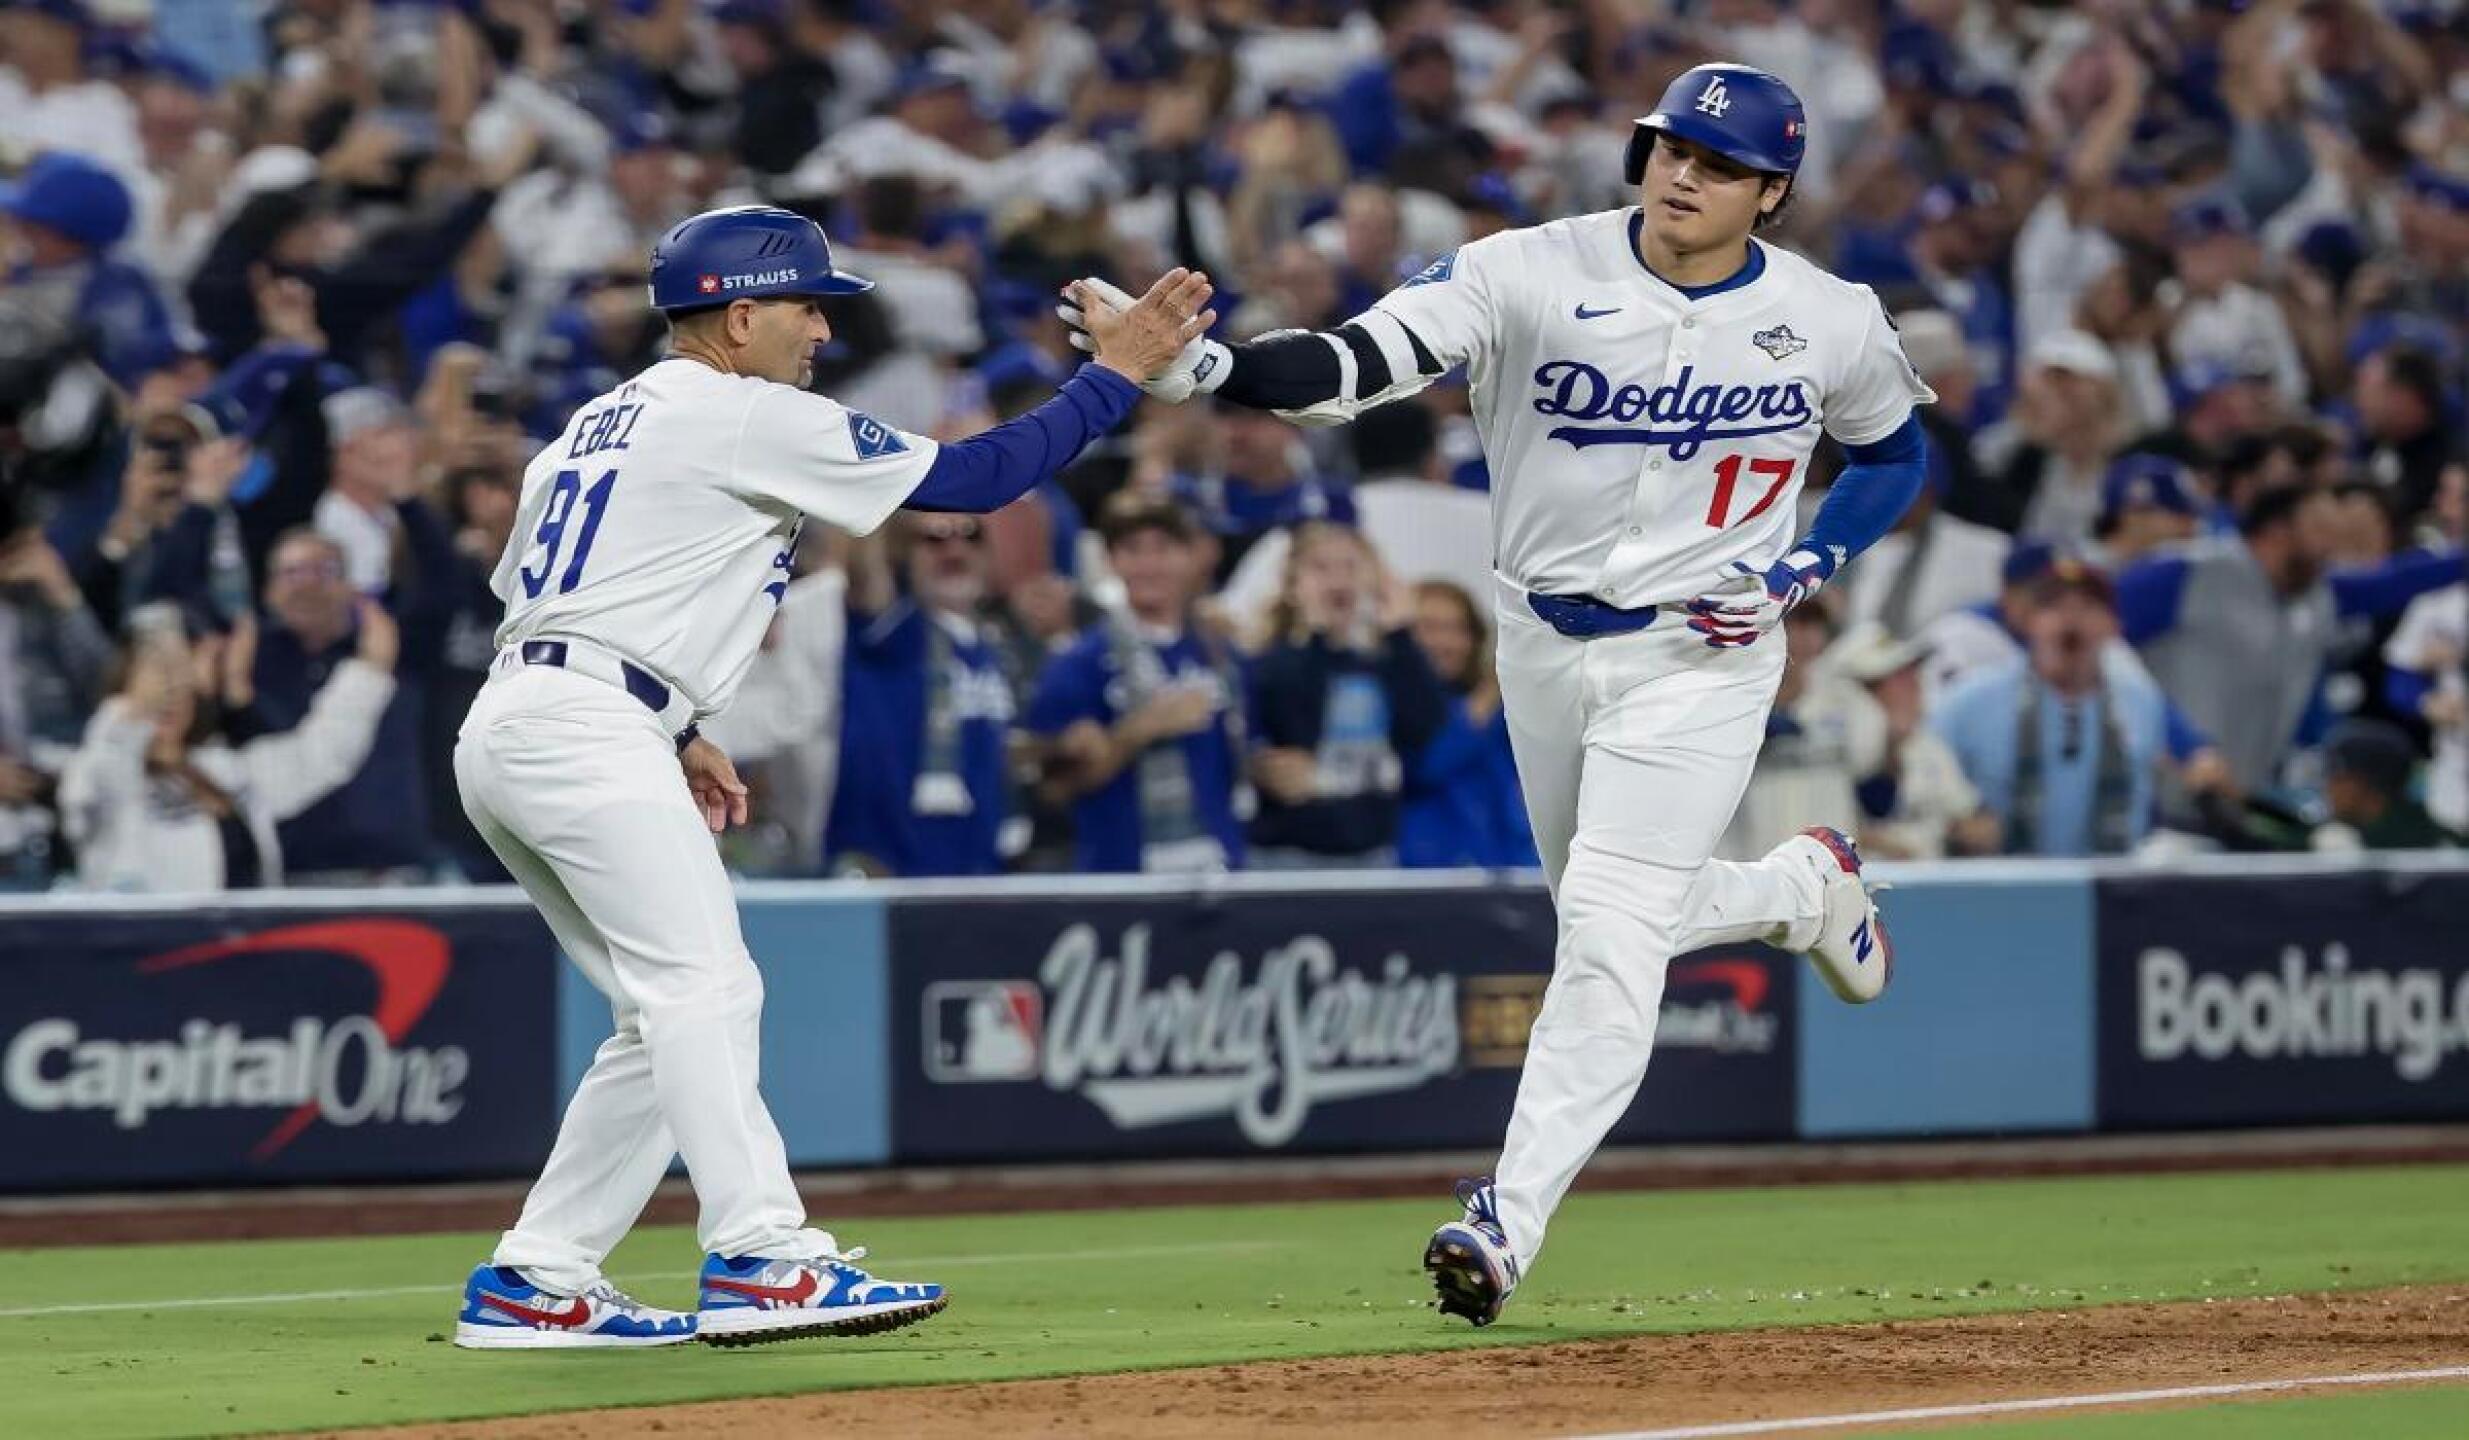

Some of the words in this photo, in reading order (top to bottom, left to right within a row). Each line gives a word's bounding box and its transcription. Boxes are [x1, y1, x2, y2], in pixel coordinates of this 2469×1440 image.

[1695, 75, 1731, 118] LA
[722, 268, 798, 289] STRAUSS
[567, 402, 646, 460] EBEL
[1533, 360, 1813, 462] Dodgers
[1706, 454, 1796, 529] 17
[520, 468, 618, 599] 91
